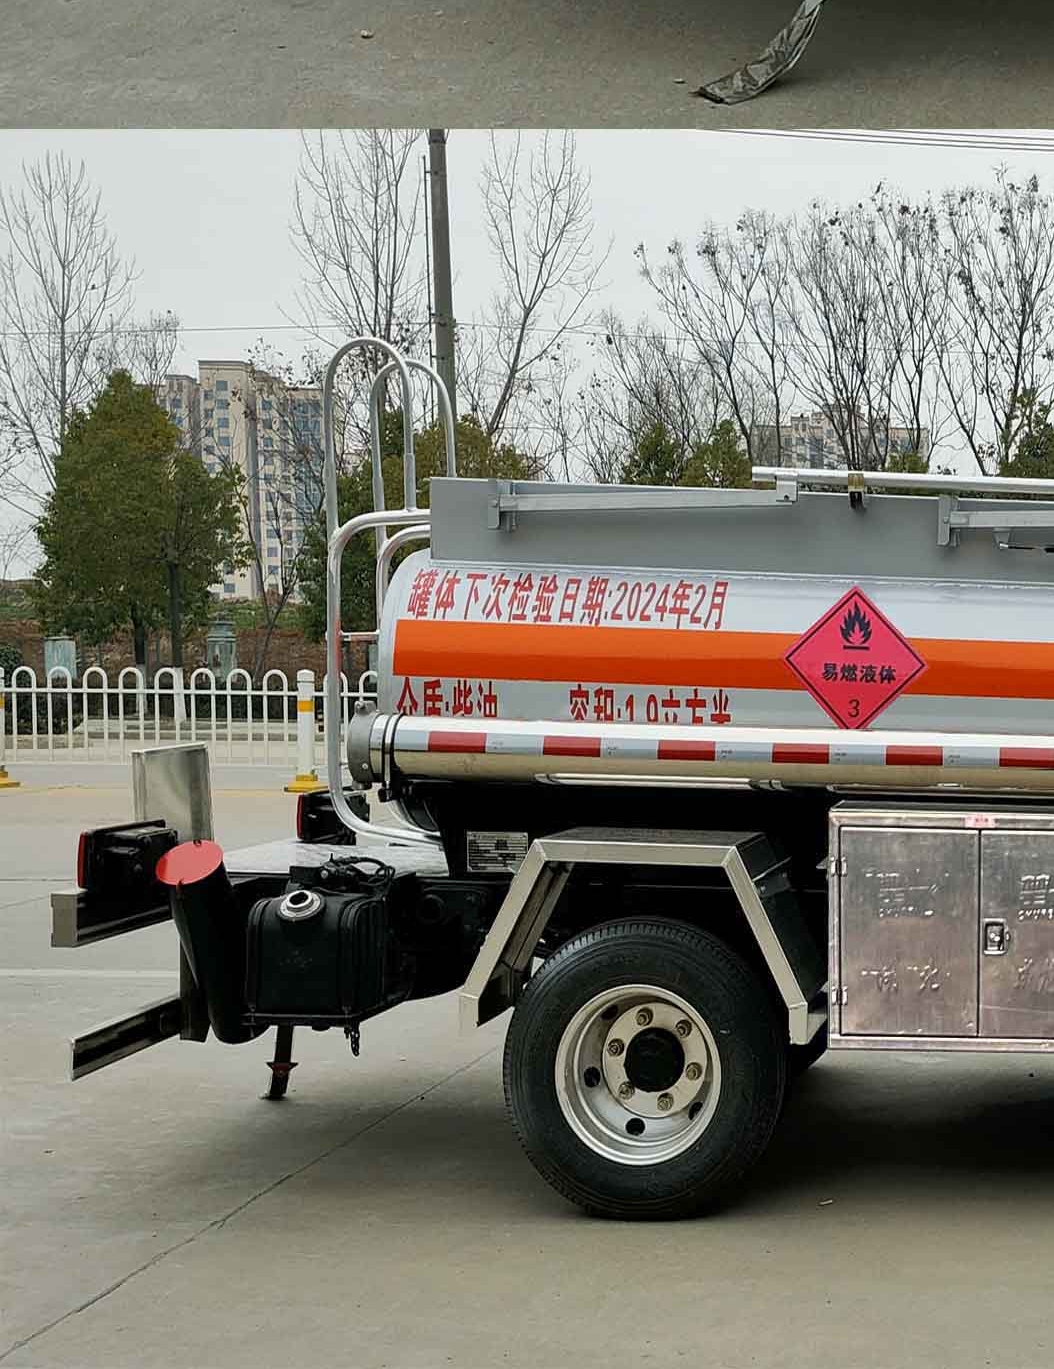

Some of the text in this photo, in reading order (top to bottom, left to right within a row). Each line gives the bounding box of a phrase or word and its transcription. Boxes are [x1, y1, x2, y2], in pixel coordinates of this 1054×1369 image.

[821, 663, 897, 684] 易燃液体
[848, 699, 860, 718] 3
